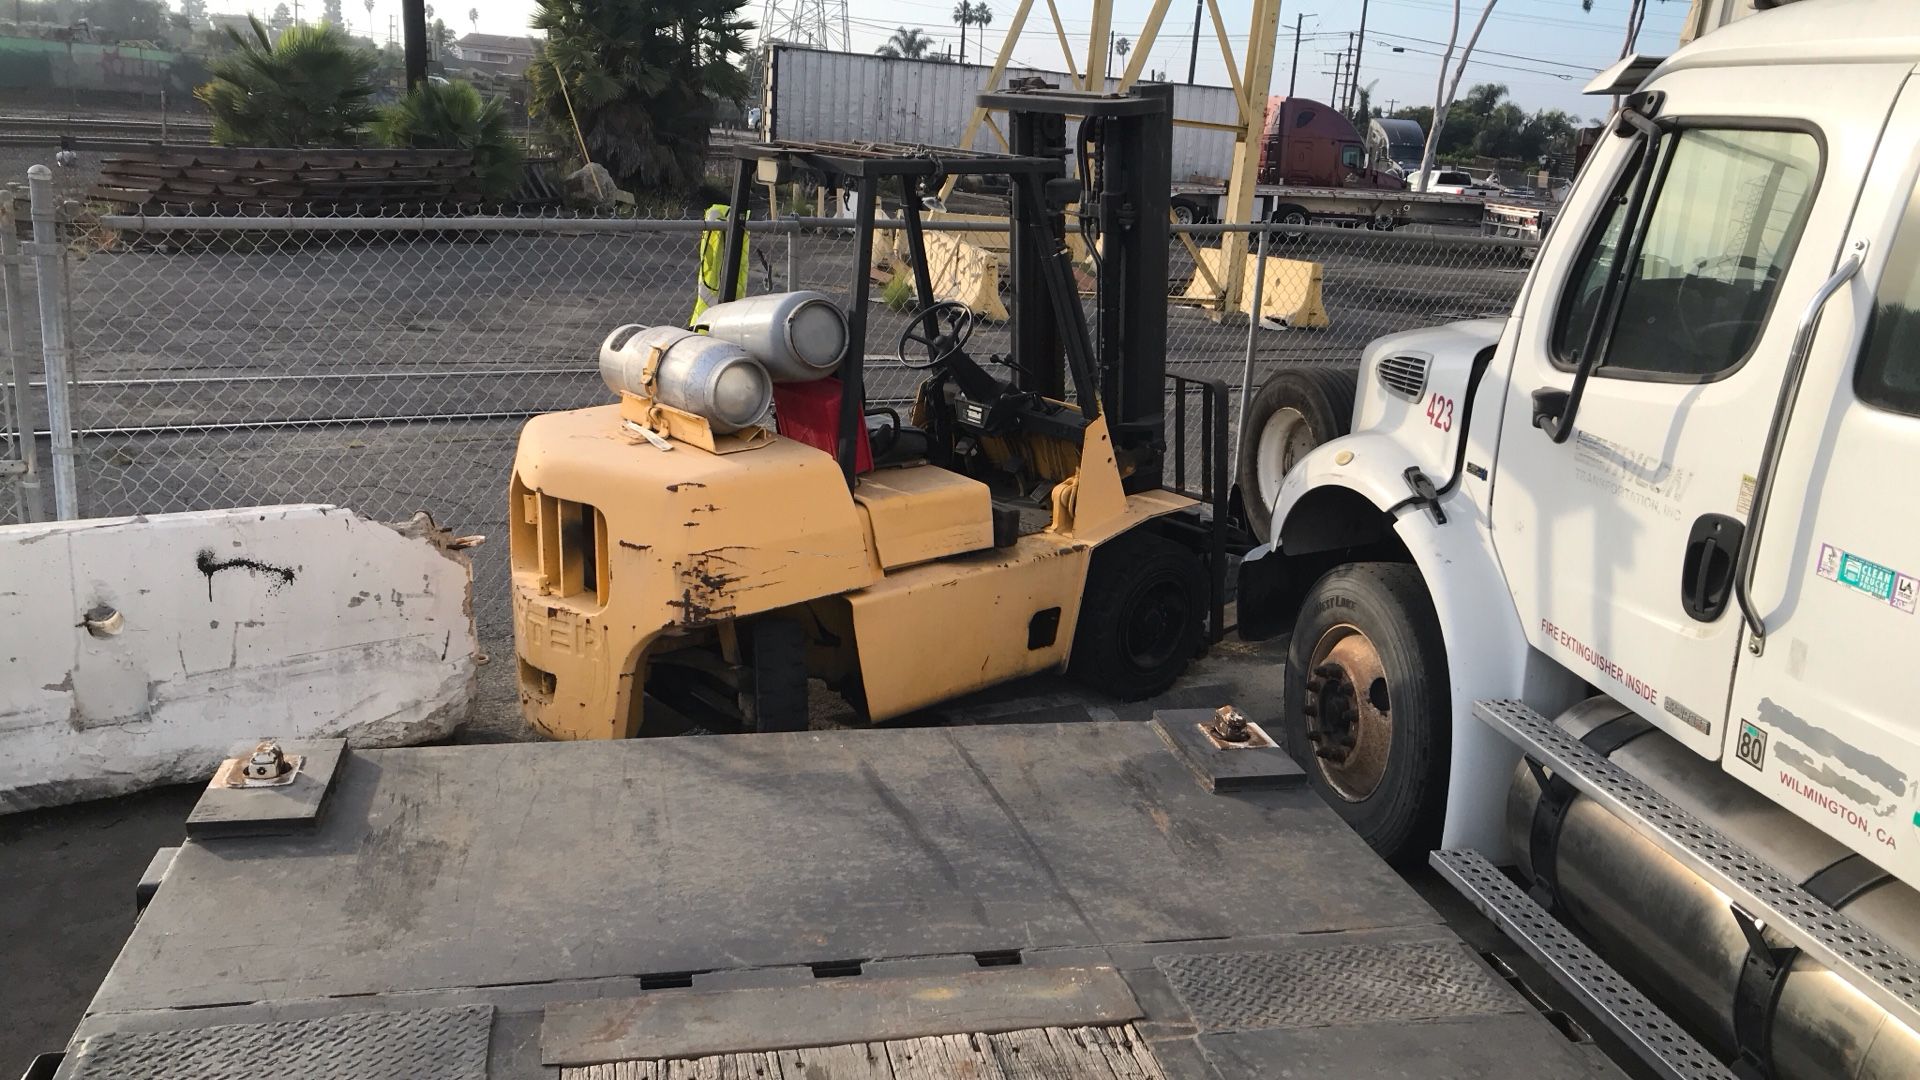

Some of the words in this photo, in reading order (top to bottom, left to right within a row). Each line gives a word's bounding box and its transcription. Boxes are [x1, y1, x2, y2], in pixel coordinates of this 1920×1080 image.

[1427, 393, 1454, 432] 423
[1860, 574, 1890, 593] TRUCKS
[1862, 565, 1892, 583] CLEAN
[1859, 582, 1889, 598] PROGRAM
[1899, 579, 1912, 595] LA
[1541, 618, 1559, 641] FIRE
[1561, 631, 1624, 683] EXTINGUISHER
[1625, 673, 1657, 705] INSIDE
[1740, 732, 1762, 764] 80
[1780, 770, 1871, 837] WILMINGTON,
[1876, 828, 1896, 850] CA
